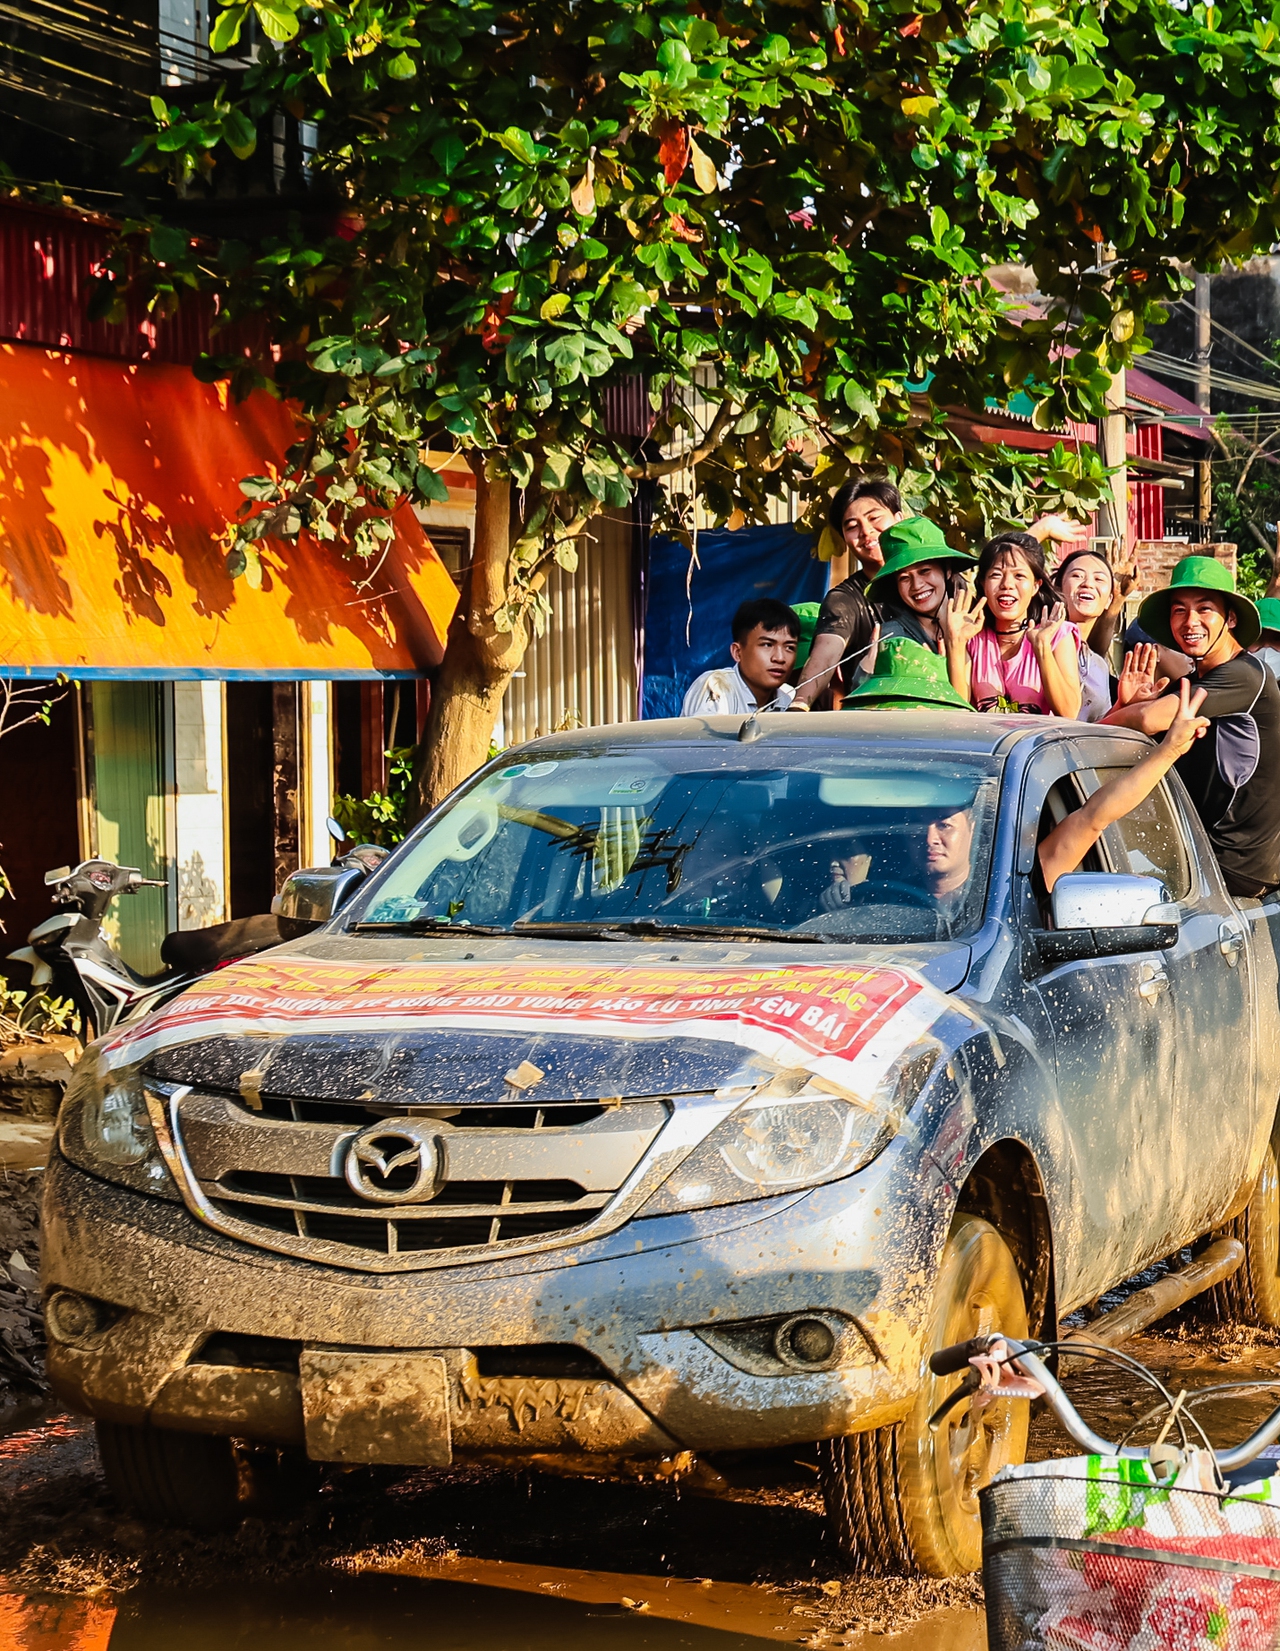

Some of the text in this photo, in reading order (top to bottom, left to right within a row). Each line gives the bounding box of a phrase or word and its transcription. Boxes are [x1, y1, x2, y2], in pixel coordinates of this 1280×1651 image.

[817, 984, 867, 1011] LẠC
[749, 995, 802, 1018] YÊN
[800, 1005, 848, 1041] BÁI
